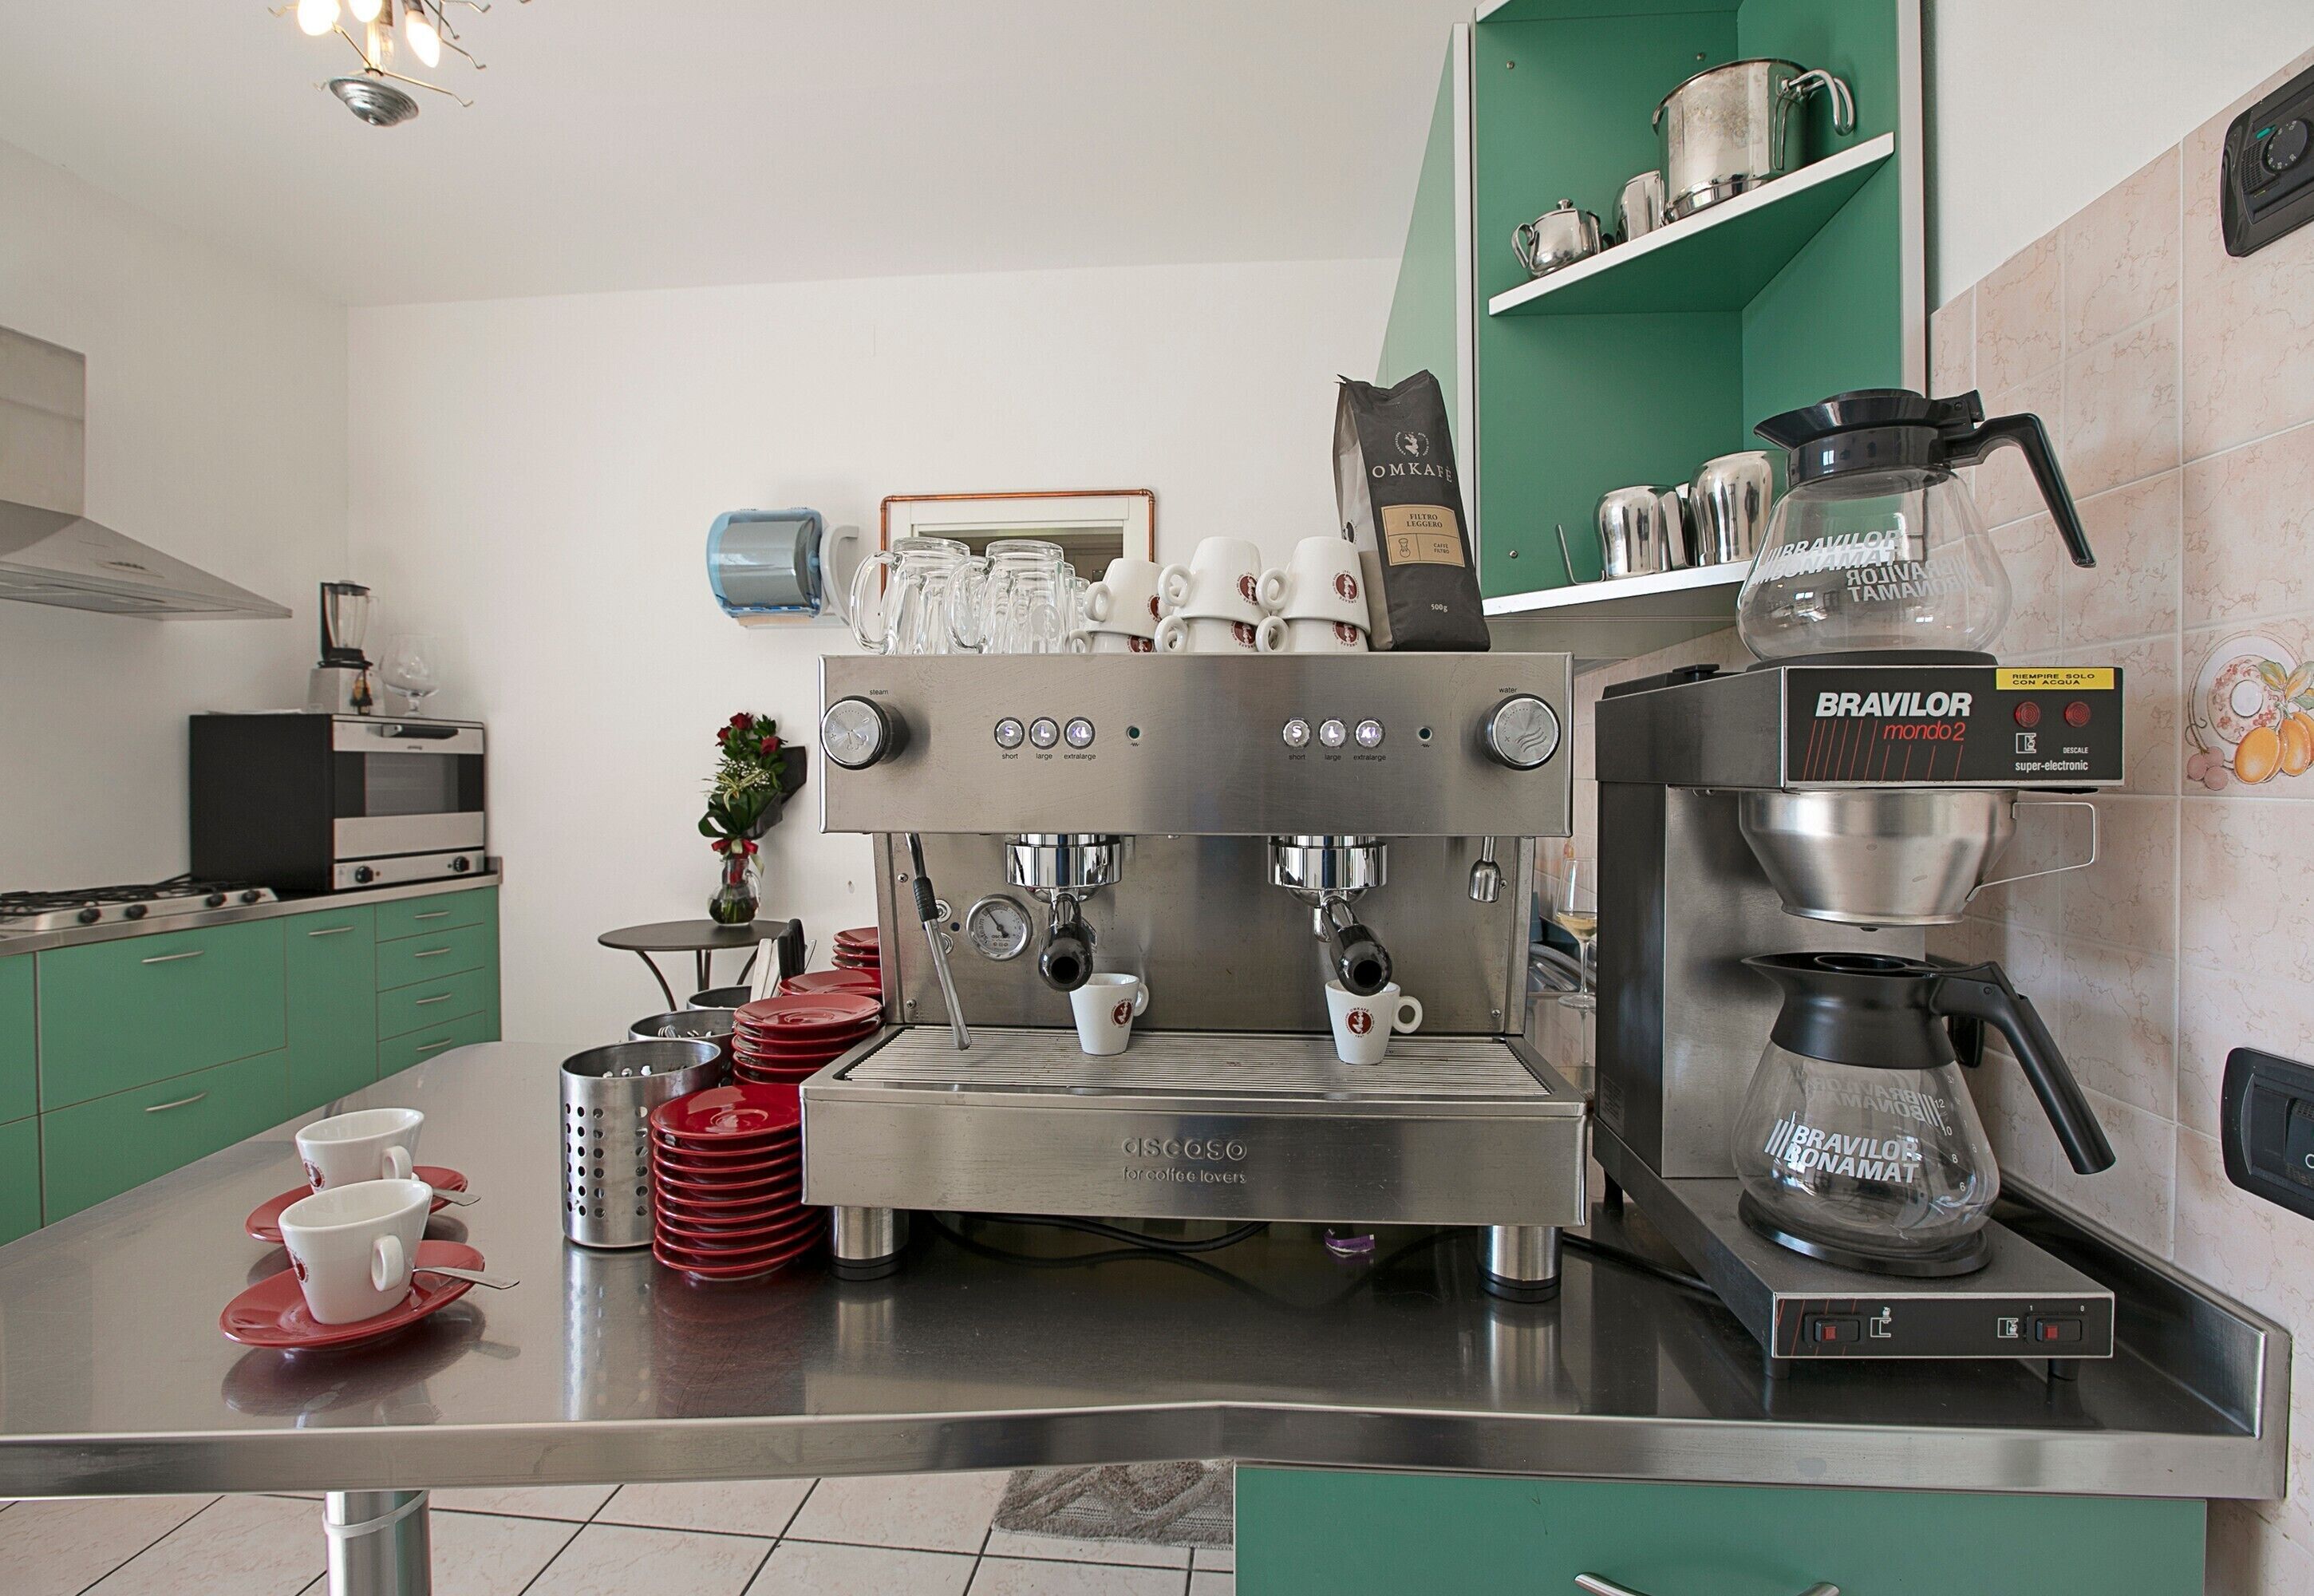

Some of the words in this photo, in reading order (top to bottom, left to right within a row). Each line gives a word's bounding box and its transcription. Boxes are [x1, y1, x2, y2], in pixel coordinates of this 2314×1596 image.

[1372, 462, 1453, 484] OMKAFÈ
[1406, 519, 1443, 528] LEGGERO
[1431, 603, 1448, 613] 500g
[1815, 692, 1972, 717] BRAVILOR
[1004, 725, 1015, 737] S
[1039, 726, 1050, 737] L
[1072, 727, 1090, 738] XL
[1292, 725, 1302, 738] S
[2015, 760, 2089, 772] super-electronic
[1934, 1099, 1945, 1108] 12
[1942, 1126, 1953, 1136] 10
[1122, 1137, 1247, 1161] ascaso
[1791, 1124, 1920, 1162] BRAVILOR
[1783, 1143, 1920, 1183] BONAMAT
[1952, 1154, 1958, 1163] 8
[1123, 1167, 1143, 1180] for
[1146, 1167, 1198, 1183] coffee
[1200, 1169, 1247, 1184] lovers
[1960, 1182, 1966, 1191] 6
